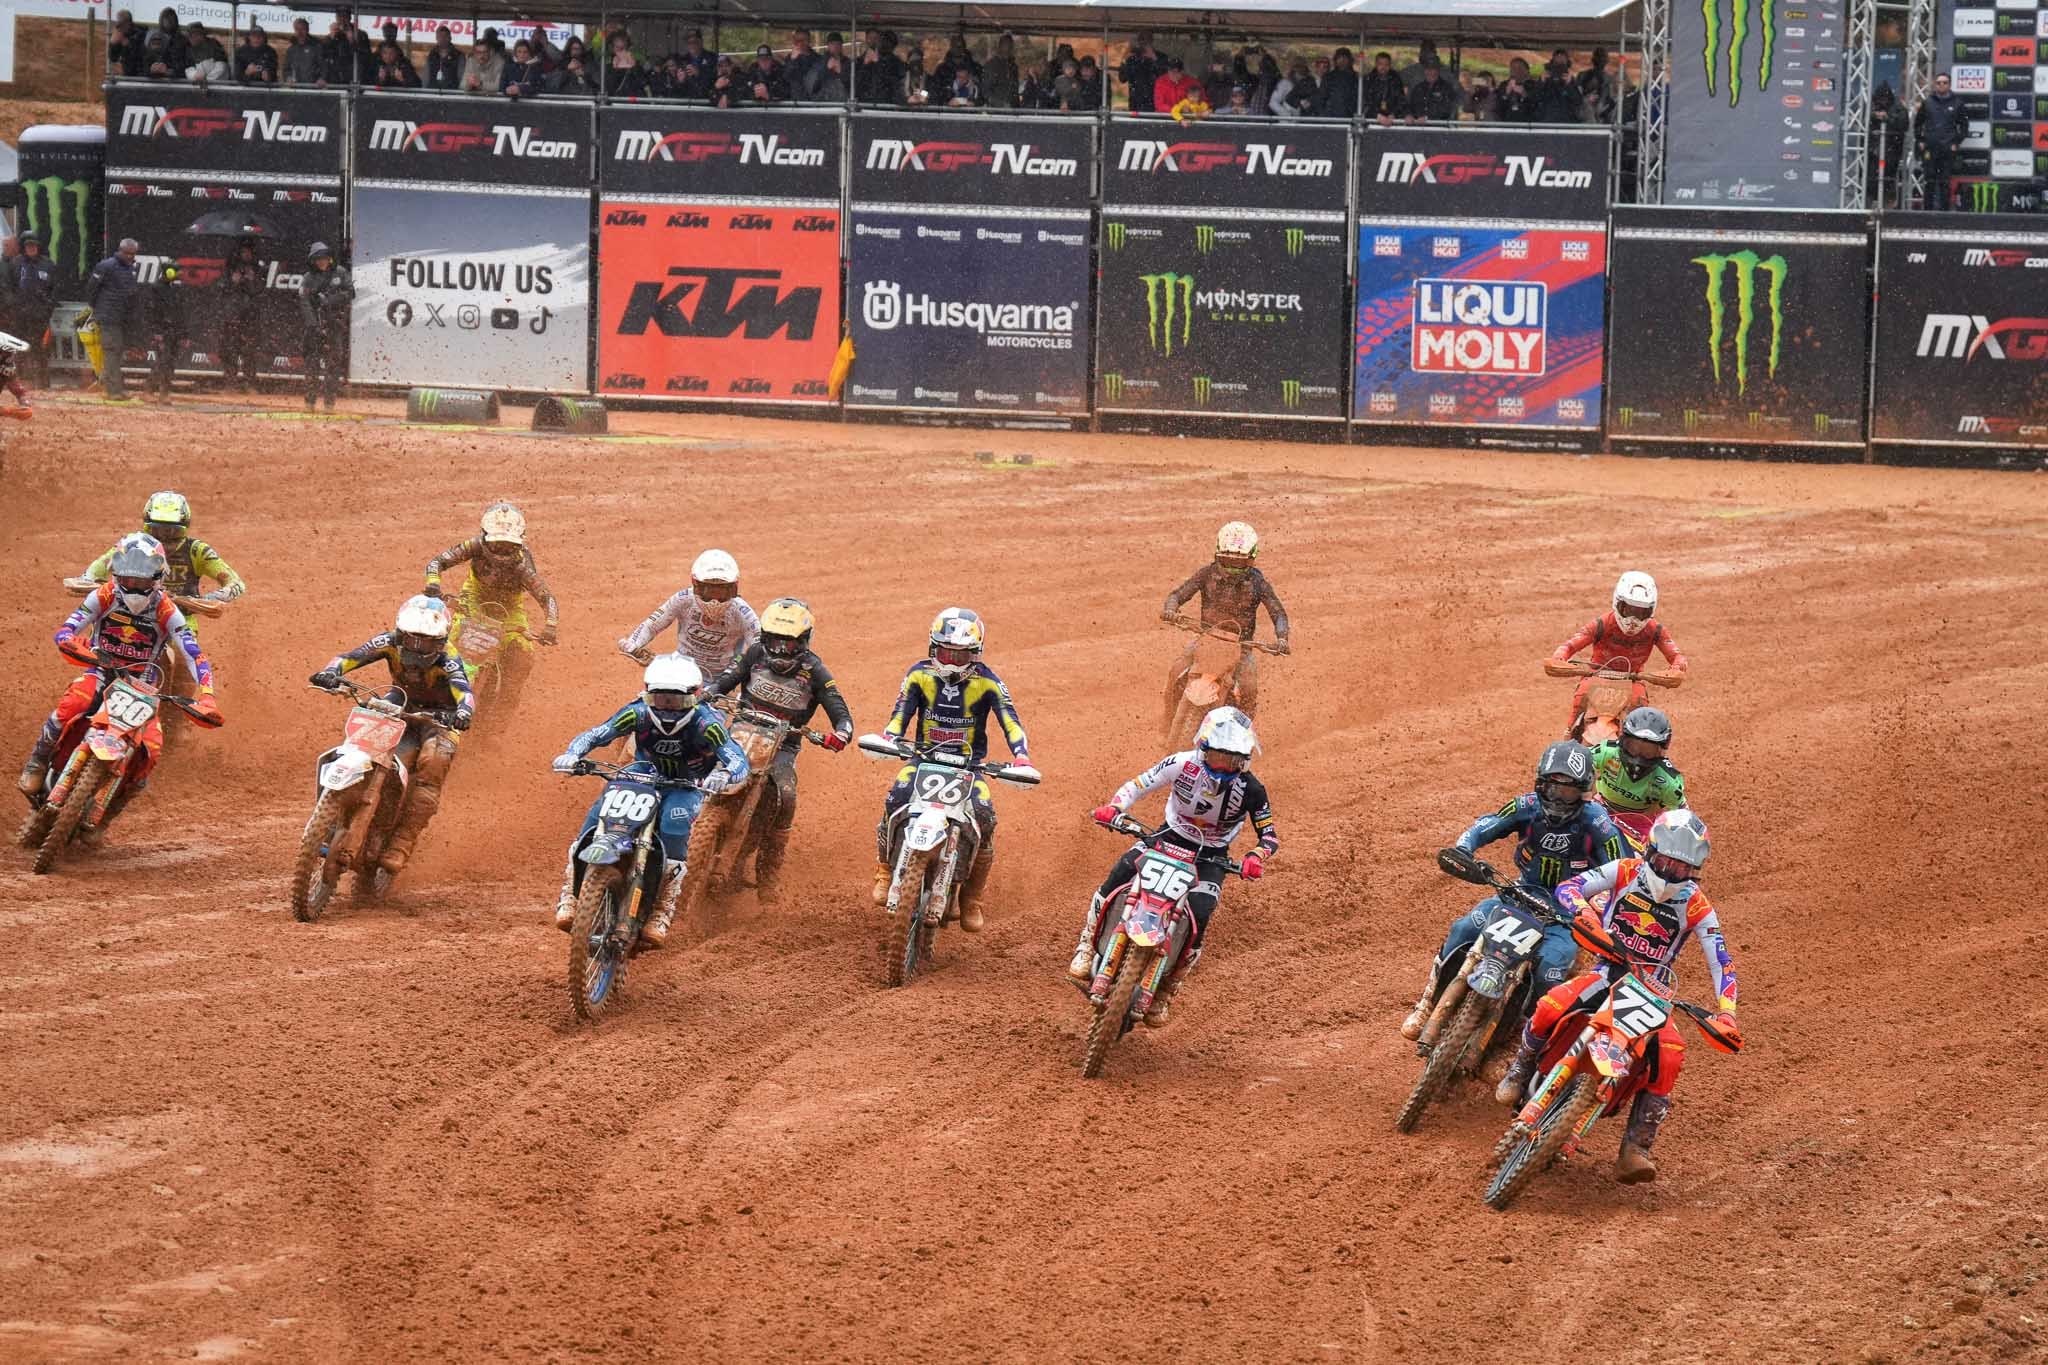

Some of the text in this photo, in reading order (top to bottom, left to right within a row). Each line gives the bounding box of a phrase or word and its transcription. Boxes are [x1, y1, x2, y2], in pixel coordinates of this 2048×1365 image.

[605, 210, 647, 226] KTM
[666, 212, 709, 228] KTM
[729, 214, 773, 230] KTM
[792, 216, 835, 232] KTM
[390, 258, 552, 294] FOLLOW US
[617, 266, 823, 341] KTM
[906, 294, 1072, 333] Husqvarna
[1196, 289, 1302, 311] MONSTER
[1420, 284, 1539, 327] LIQUI
[1211, 313, 1288, 322] ENERGY
[987, 335, 1072, 349] MOTORCYCLES
[1420, 329, 1541, 370] MOLY
[108, 690, 154, 726] 80
[922, 774, 962, 803] 96
[599, 789, 656, 822] 198
[1140, 859, 1194, 900] 516
[1485, 916, 1543, 956] 44
[1635, 936, 1668, 960] Bull
[1613, 985, 1667, 1037] 72
